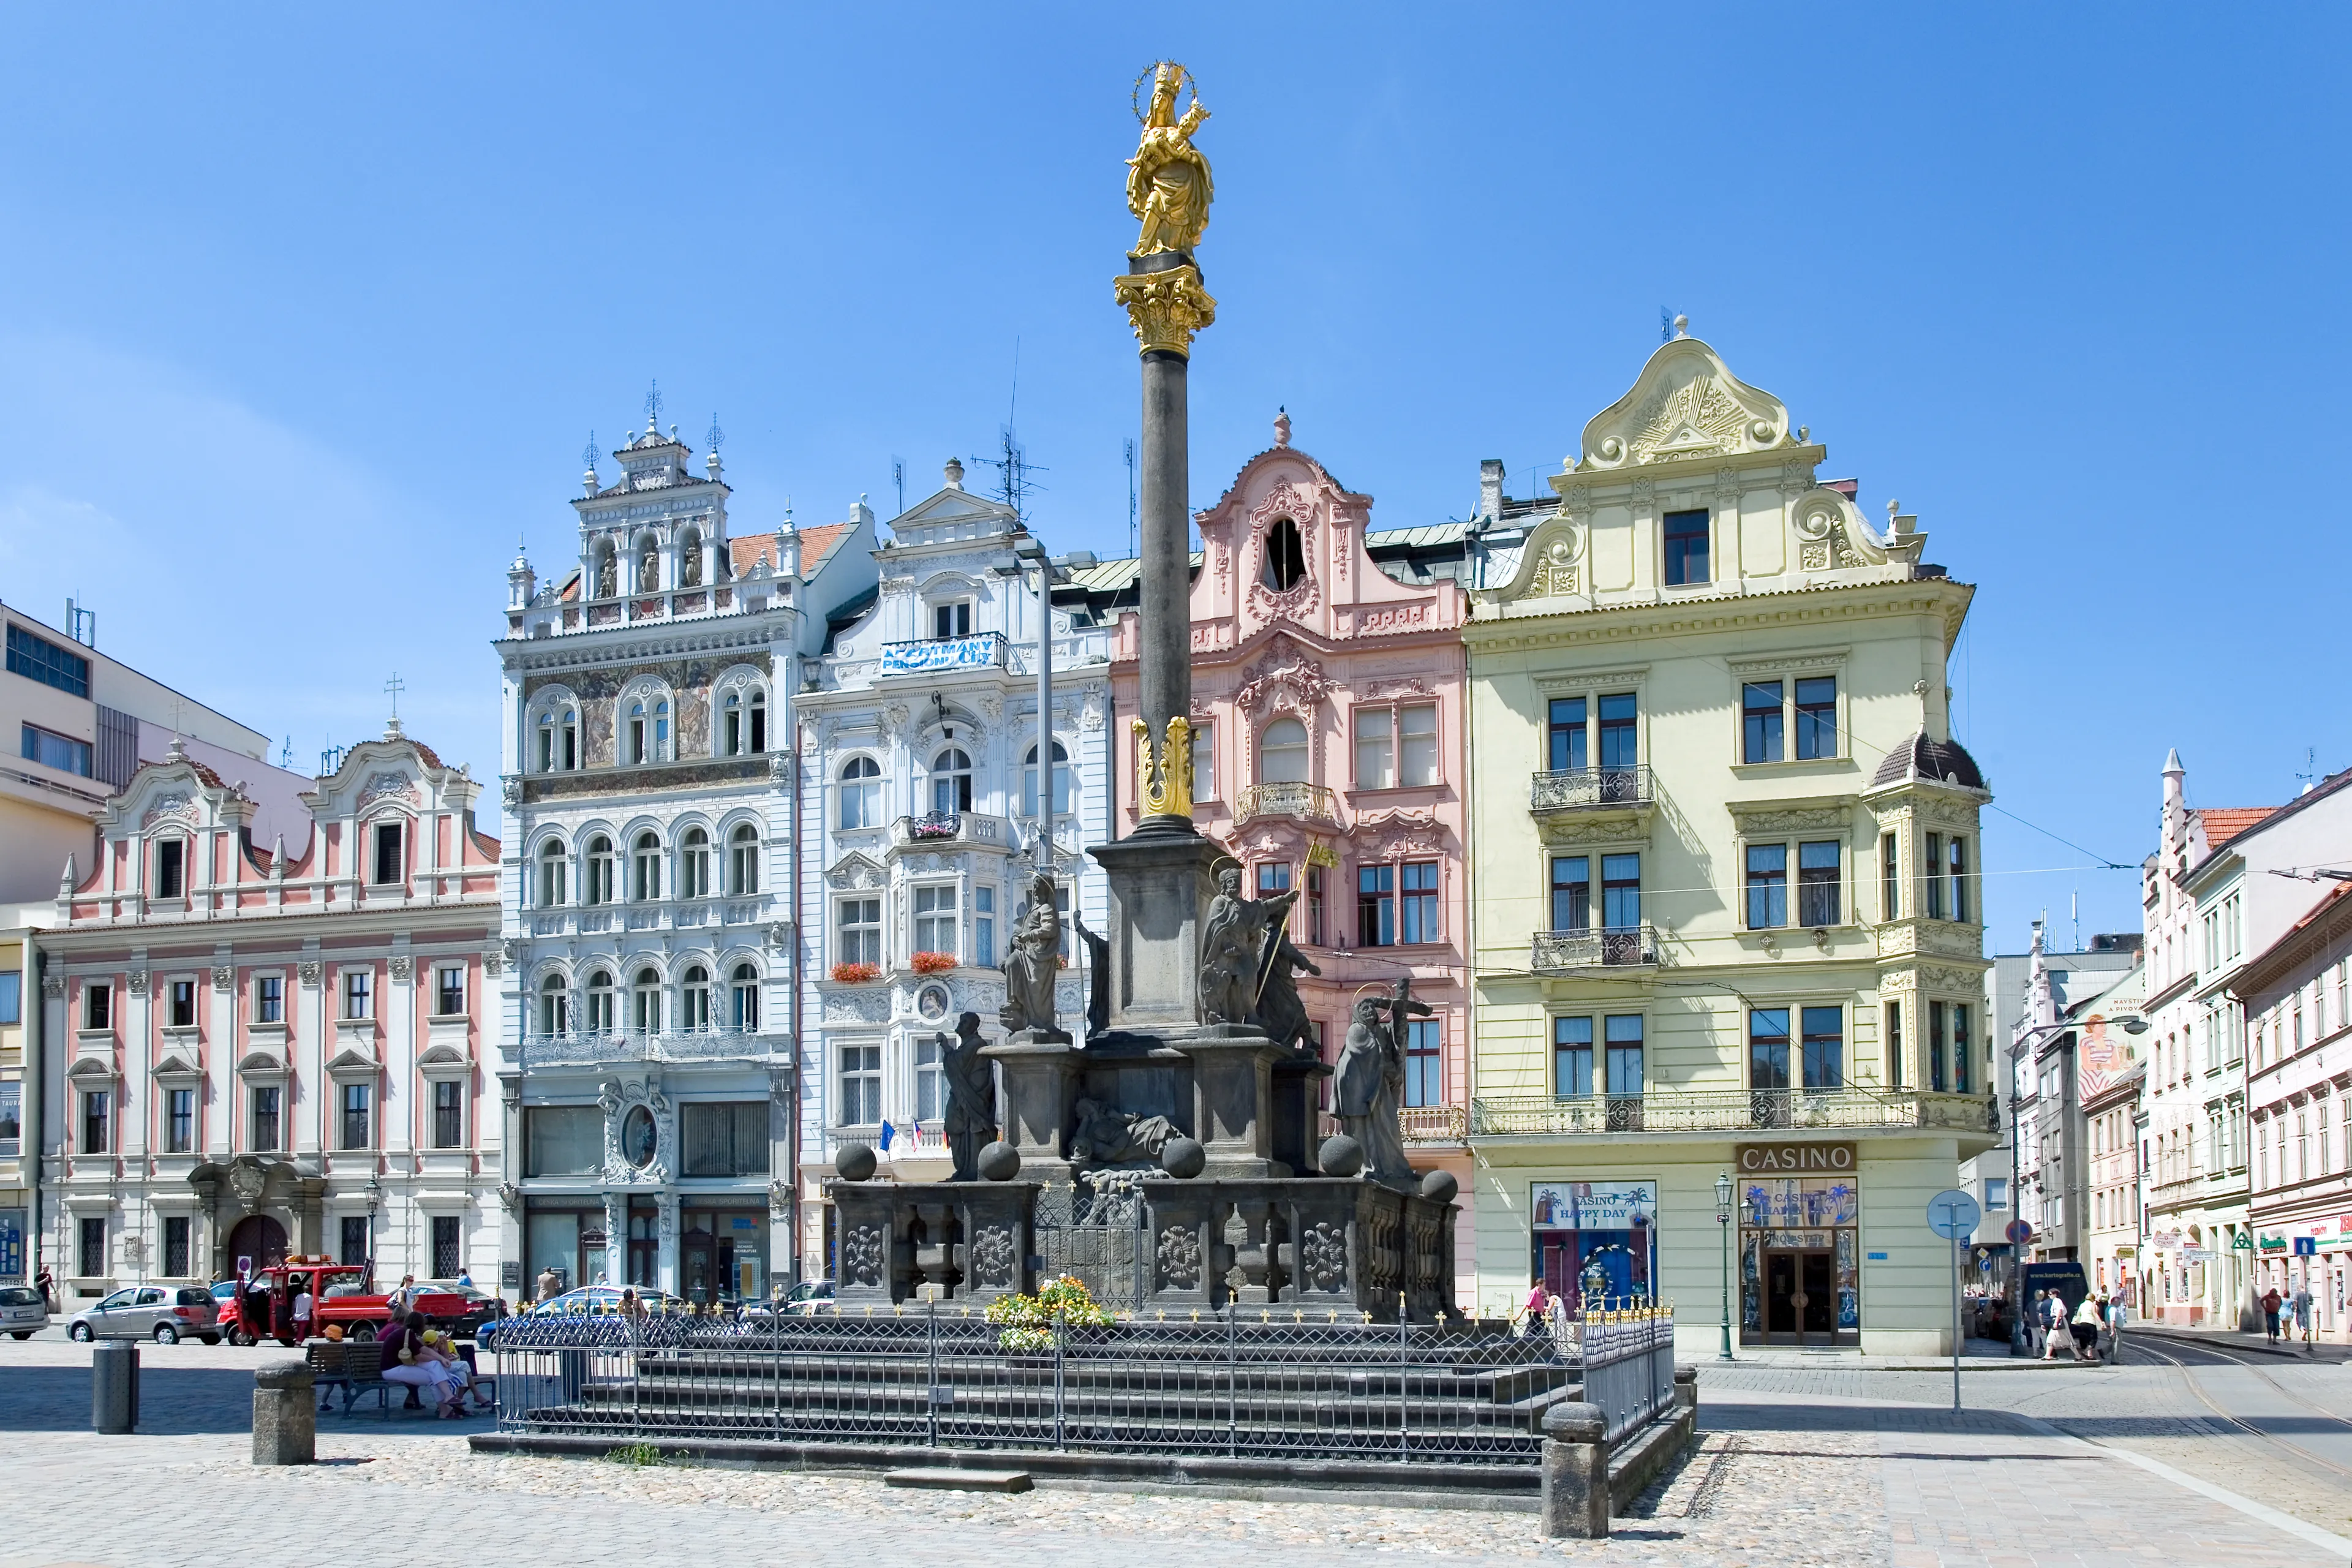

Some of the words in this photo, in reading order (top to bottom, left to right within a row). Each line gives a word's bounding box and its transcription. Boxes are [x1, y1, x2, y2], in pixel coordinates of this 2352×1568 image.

[959, 650, 992, 665] City
[635, 665, 657, 674] 1894
[1743, 1147, 1850, 1170] CASINO
[1575, 1197, 1616, 1205] CASINO
[1774, 1193, 1823, 1202] CASINO
[1560, 1209, 1600, 1218] HAPPY
[1602, 1208, 1627, 1218] DAY
[1745, 1239, 1757, 1322] CASINO
